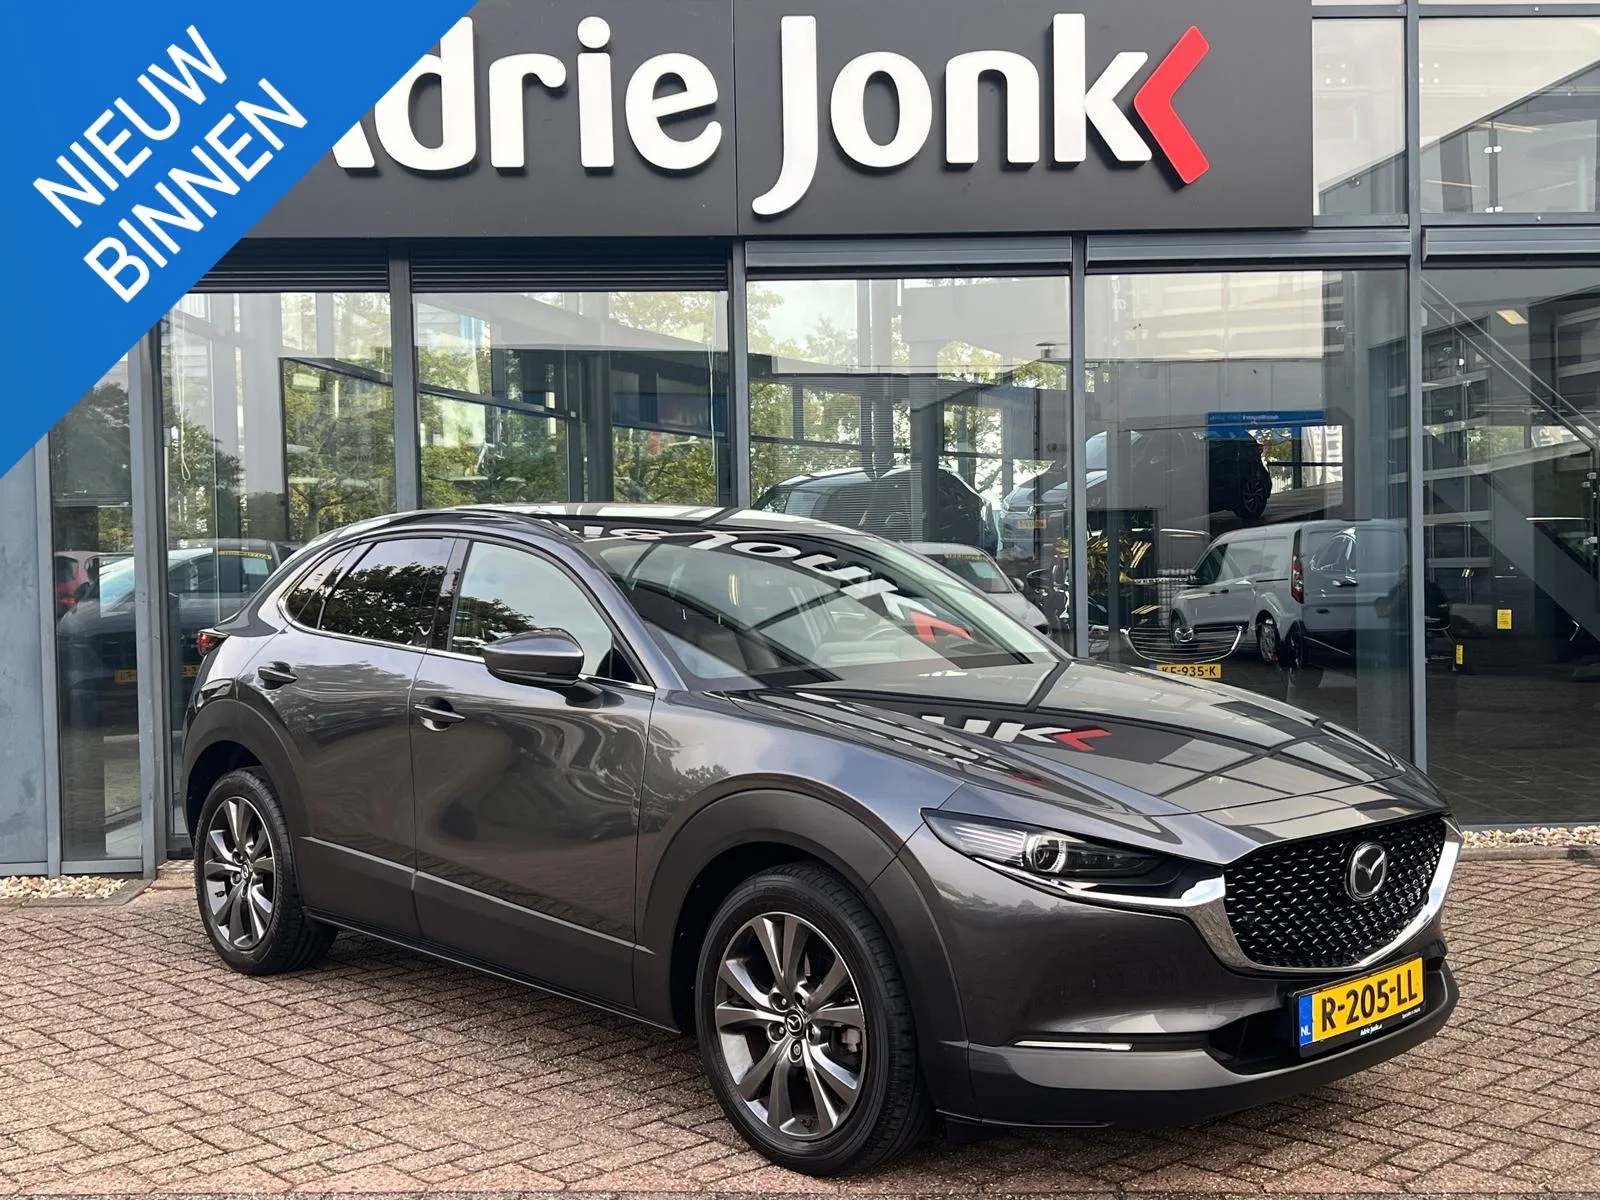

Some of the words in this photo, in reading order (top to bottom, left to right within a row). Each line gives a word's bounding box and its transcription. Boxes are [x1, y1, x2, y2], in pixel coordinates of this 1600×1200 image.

[752, 13, 1152, 217] Jonk
[1300, 1024, 1311, 1037] NL
[1321, 969, 1418, 1032] R-205-LL
